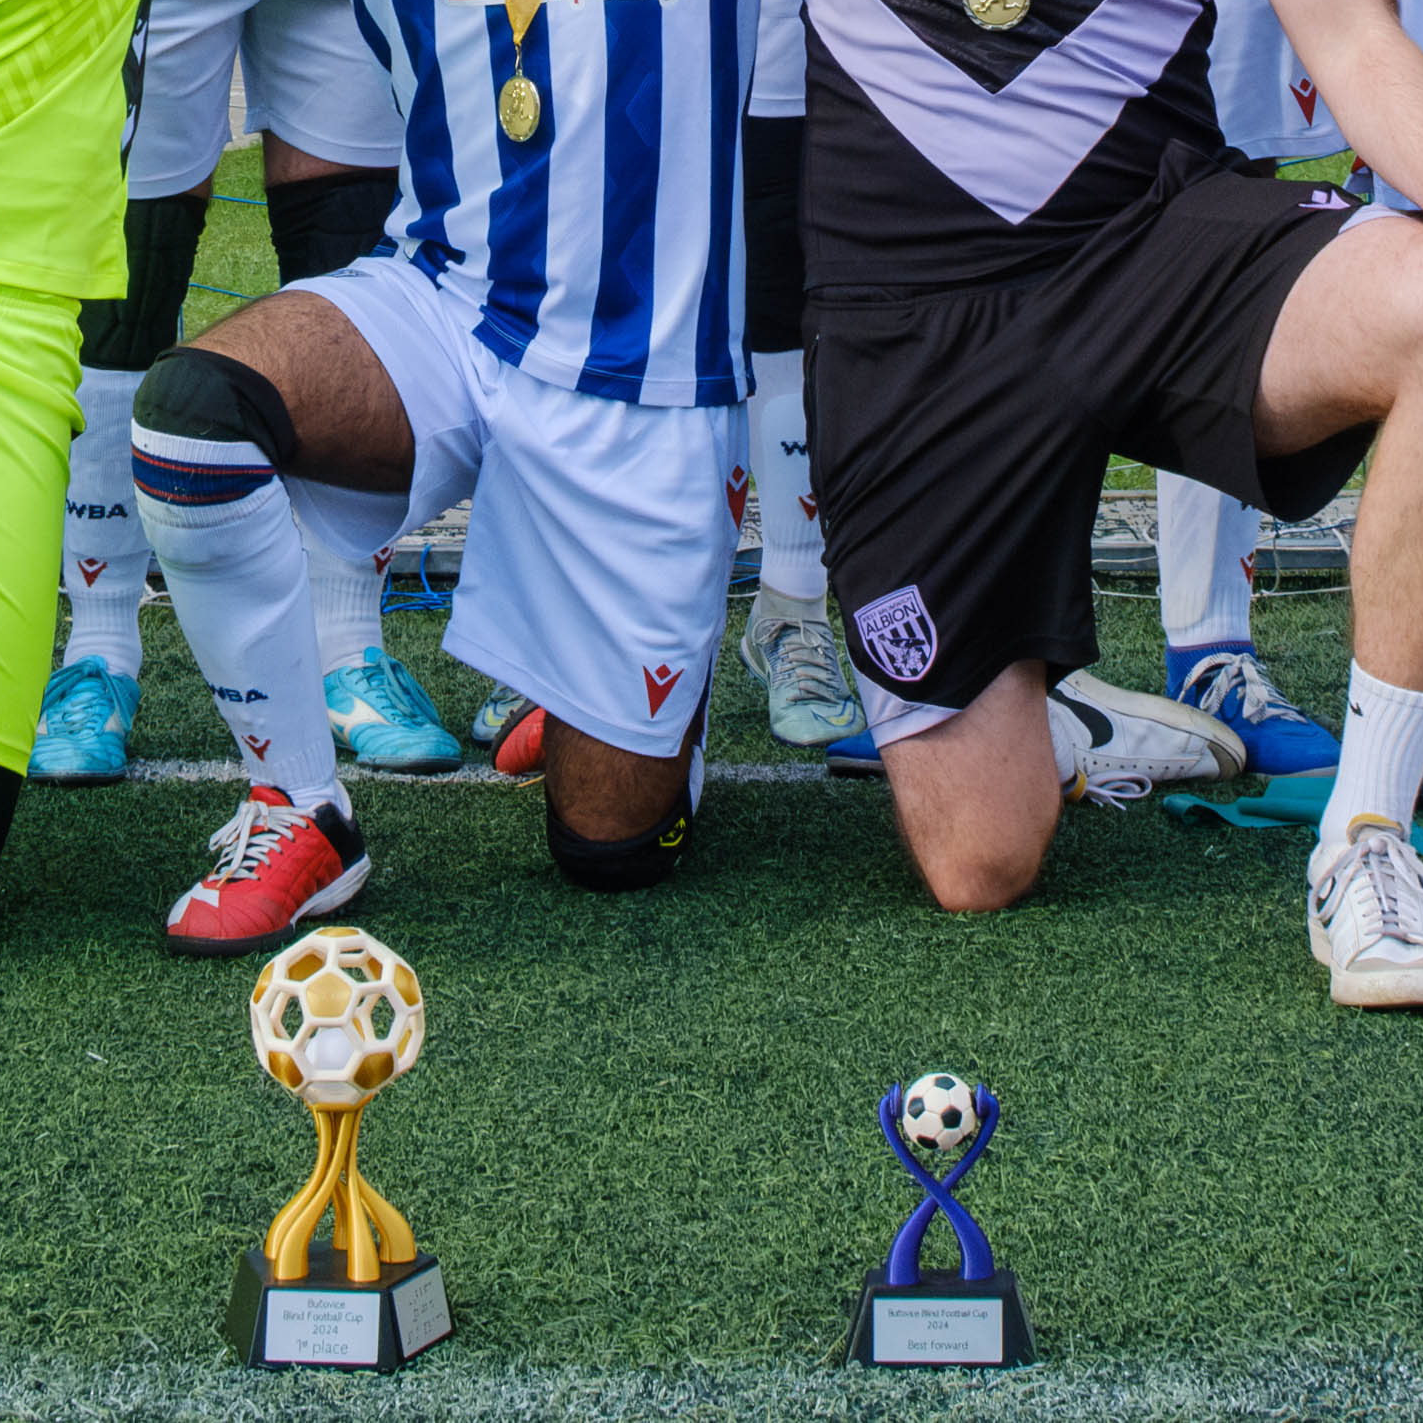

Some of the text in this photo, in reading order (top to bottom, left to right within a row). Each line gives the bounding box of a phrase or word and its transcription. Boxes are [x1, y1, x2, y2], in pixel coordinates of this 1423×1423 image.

[65, 498, 128, 519] WBA
[865, 601, 918, 637] ALBION
[283, 1310, 364, 1324] Blind Football Cup
[312, 1324, 339, 1335] 2024
[927, 1320, 949, 1330] 2024
[312, 1339, 349, 1357] place
[907, 1339, 928, 1351] Best
